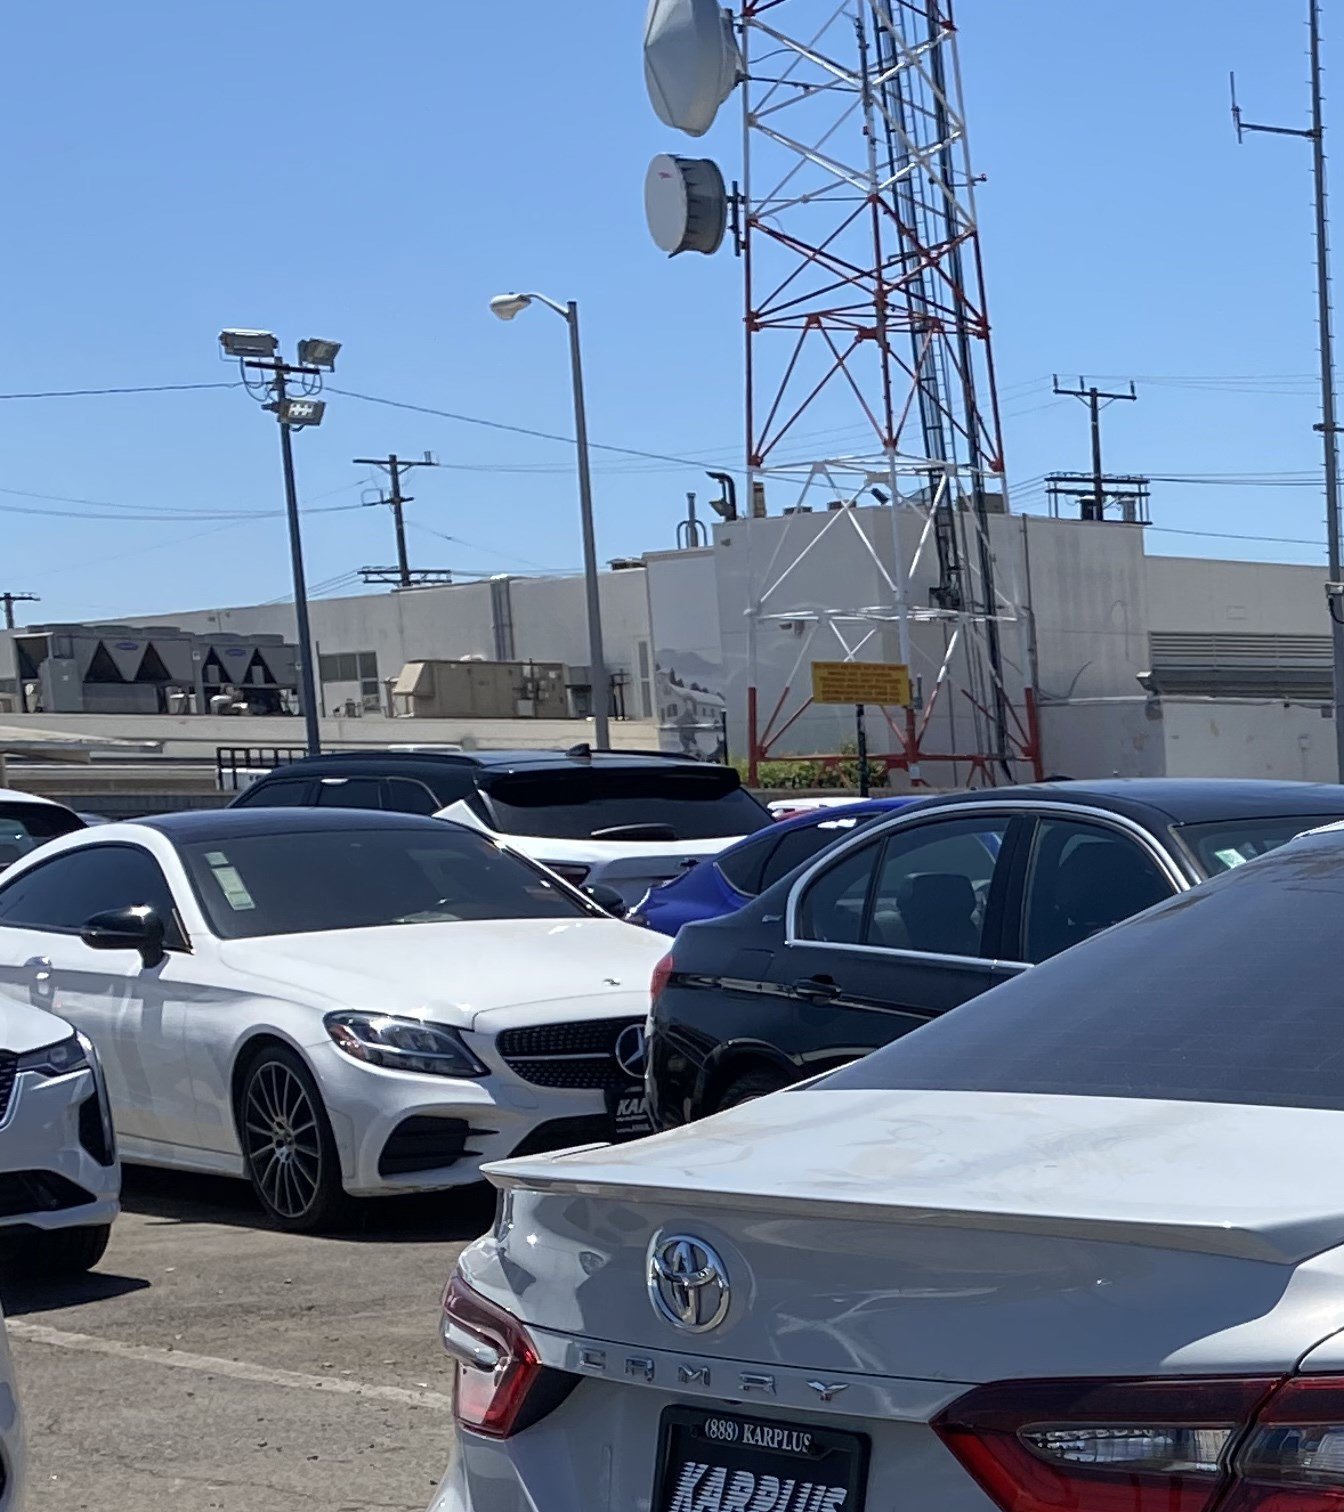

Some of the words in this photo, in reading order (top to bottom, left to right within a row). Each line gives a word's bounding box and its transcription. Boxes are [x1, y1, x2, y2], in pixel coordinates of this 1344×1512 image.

[579, 1347, 850, 1402] CAMRY
[704, 1417, 739, 1441] (888)
[742, 1424, 812, 1452] KARPLUS
